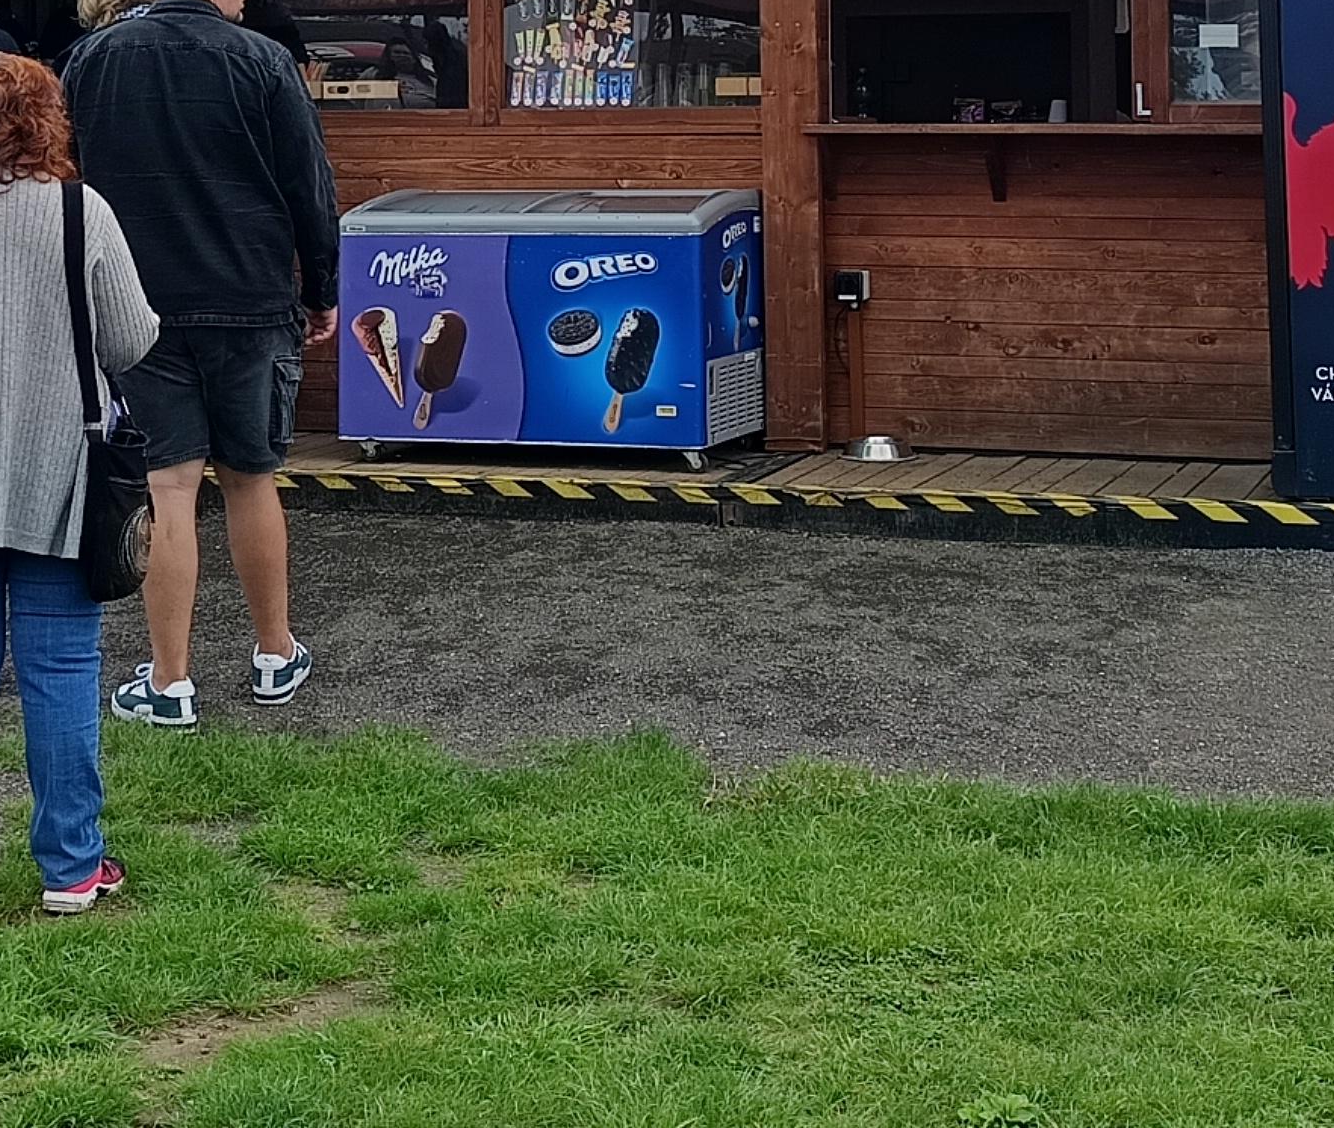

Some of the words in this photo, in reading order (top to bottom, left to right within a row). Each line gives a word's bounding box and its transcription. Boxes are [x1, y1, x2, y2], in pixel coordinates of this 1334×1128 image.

[722, 222, 747, 249] OREO
[369, 243, 449, 286] Milka
[554, 253, 656, 287] OREO
